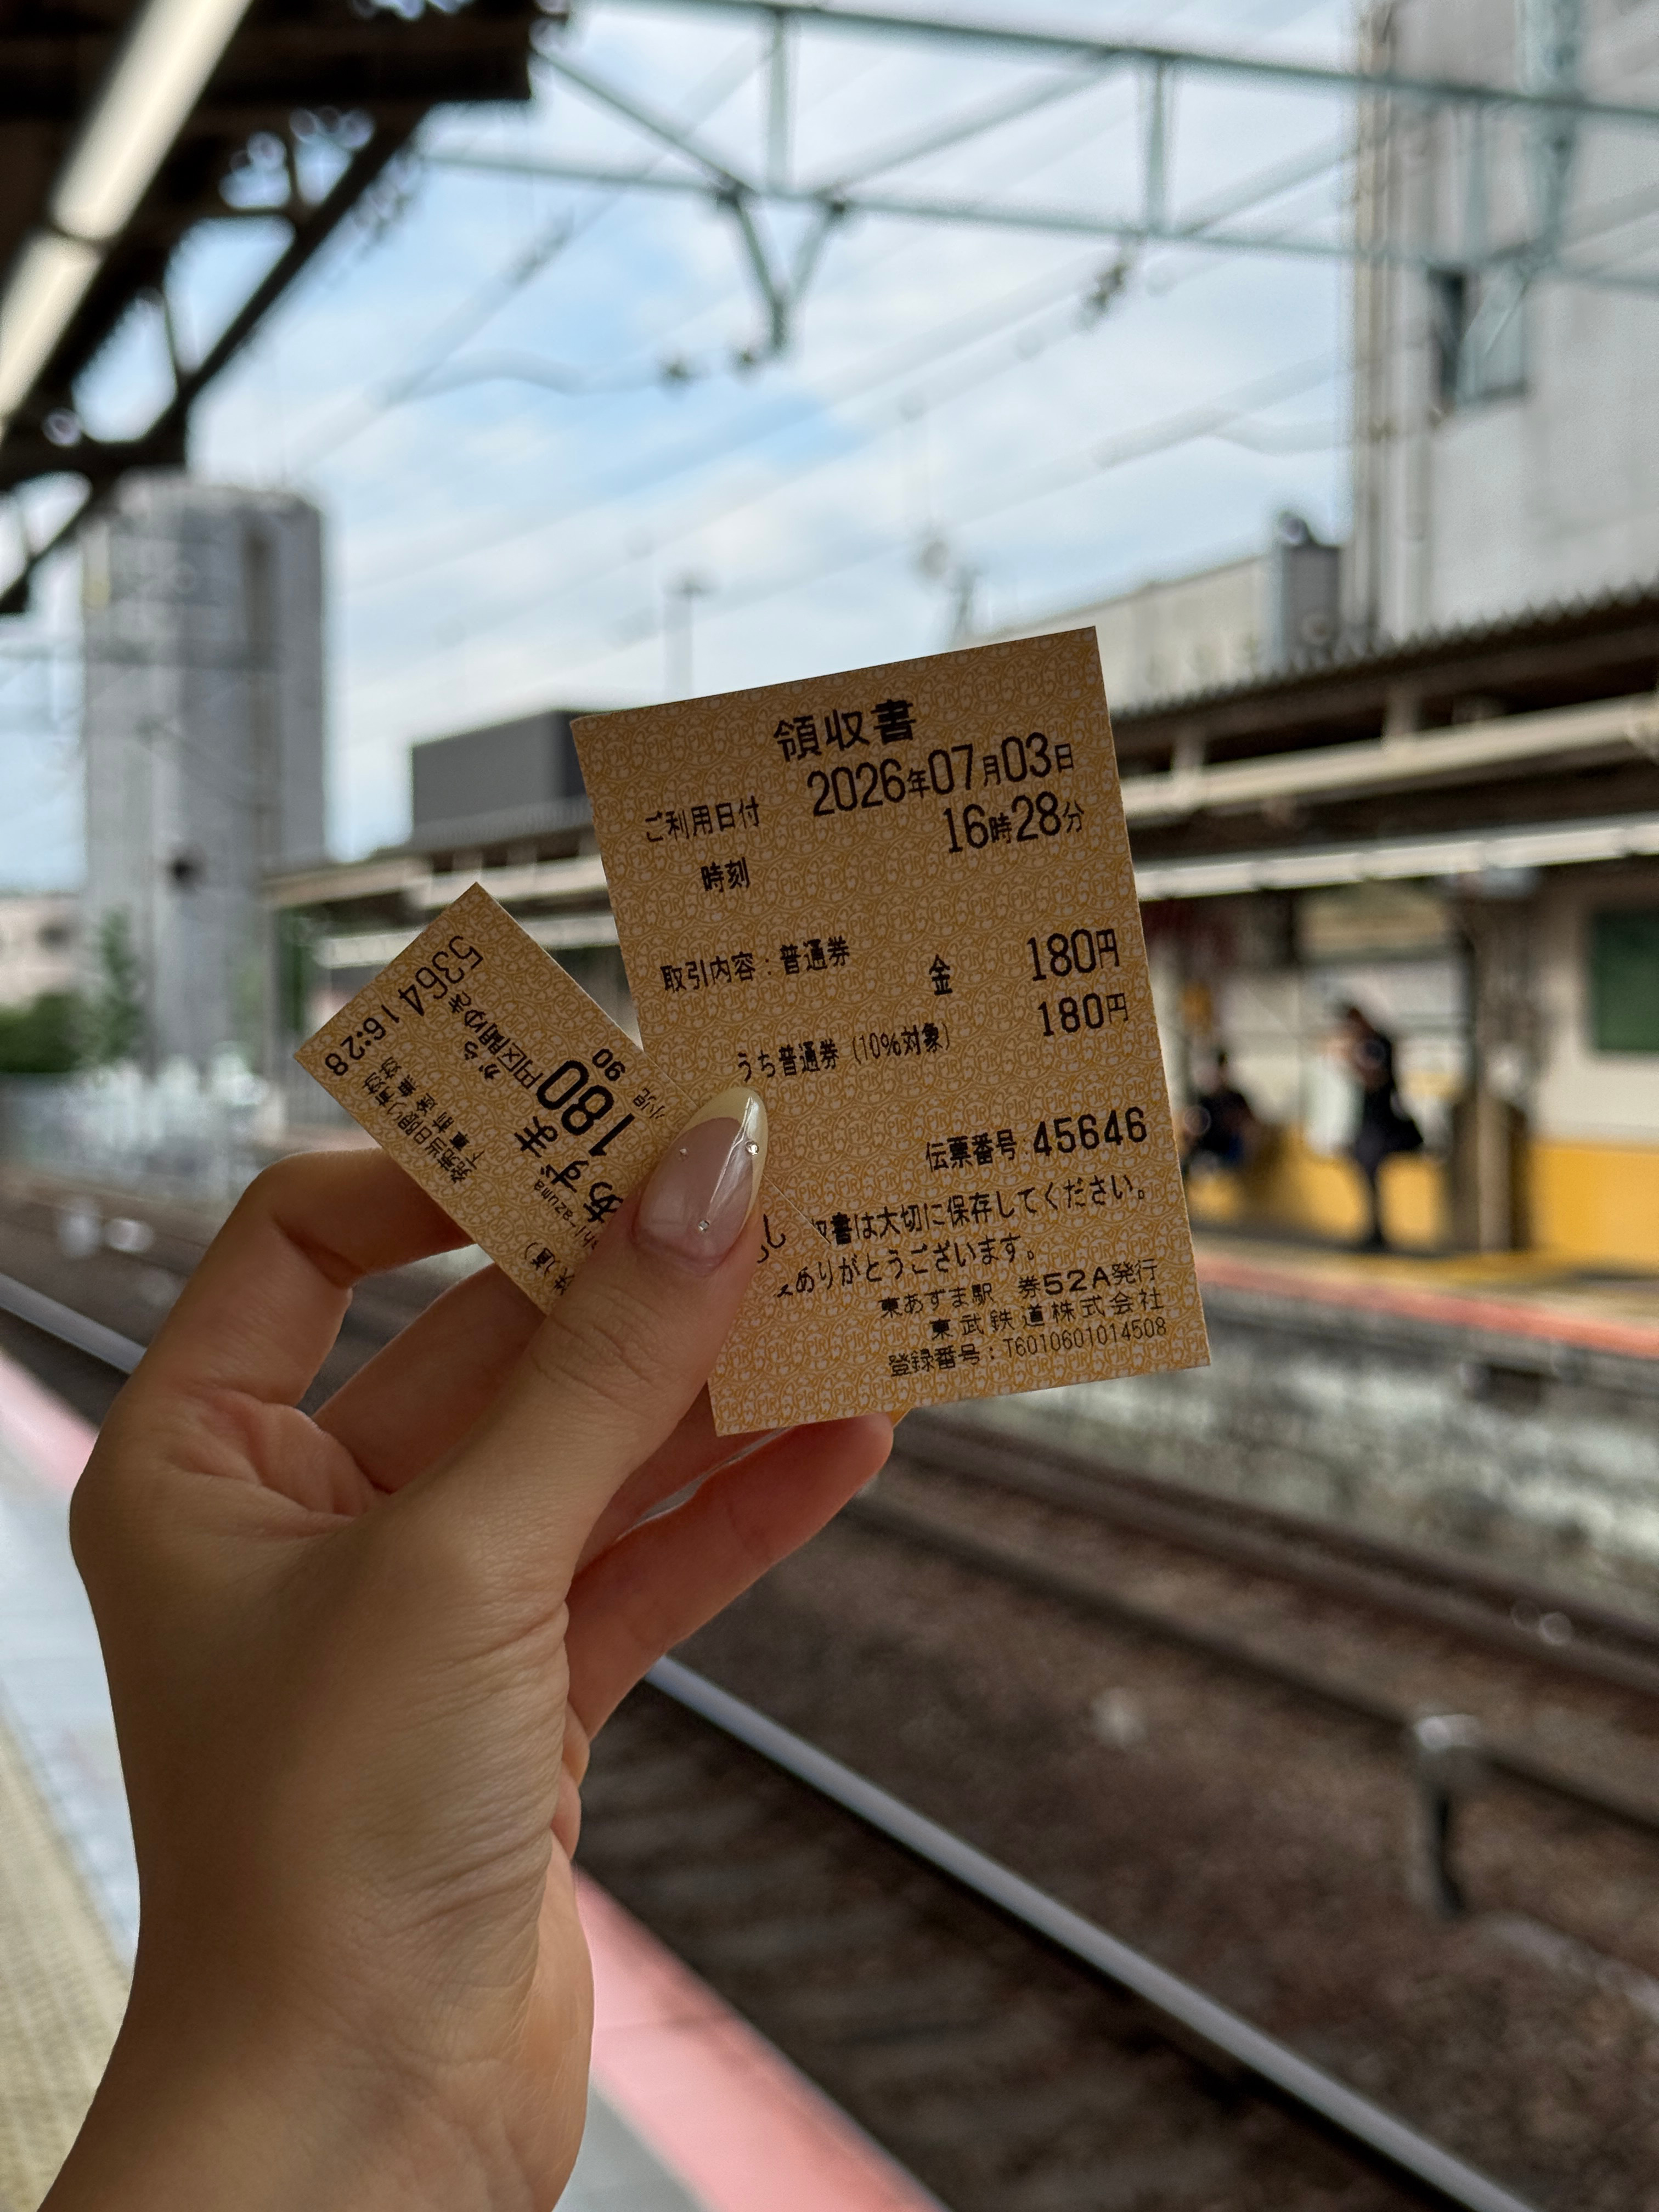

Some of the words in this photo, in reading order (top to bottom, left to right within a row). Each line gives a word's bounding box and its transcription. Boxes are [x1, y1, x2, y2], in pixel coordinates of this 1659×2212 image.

[773, 699, 916, 762] 領収書
[645, 795, 759, 842] ご利用日付
[807, 732, 1074, 817] 2026年07月03日
[701, 856, 750, 893] 時刻
[943, 791, 1084, 854] 16時28分
[398, 935, 483, 1017] 5364
[929, 954, 952, 996] 金
[1026, 928, 1120, 981] 180円
[325, 1005, 399, 1076] 16:28
[1038, 993, 1128, 1036] 180円
[592, 1049, 625, 1081] 90
[362, 1072, 472, 1183] 発売当日限り有効
[379, 1057, 484, 1170] 下車前途無効
[633, 1087, 665, 1119] 小児
[878, 1283, 994, 1318] 東あずま駅
[1018, 1259, 1157, 1299] 券52A発行
[929, 1287, 1164, 1341] 東武鉄道株式会社
